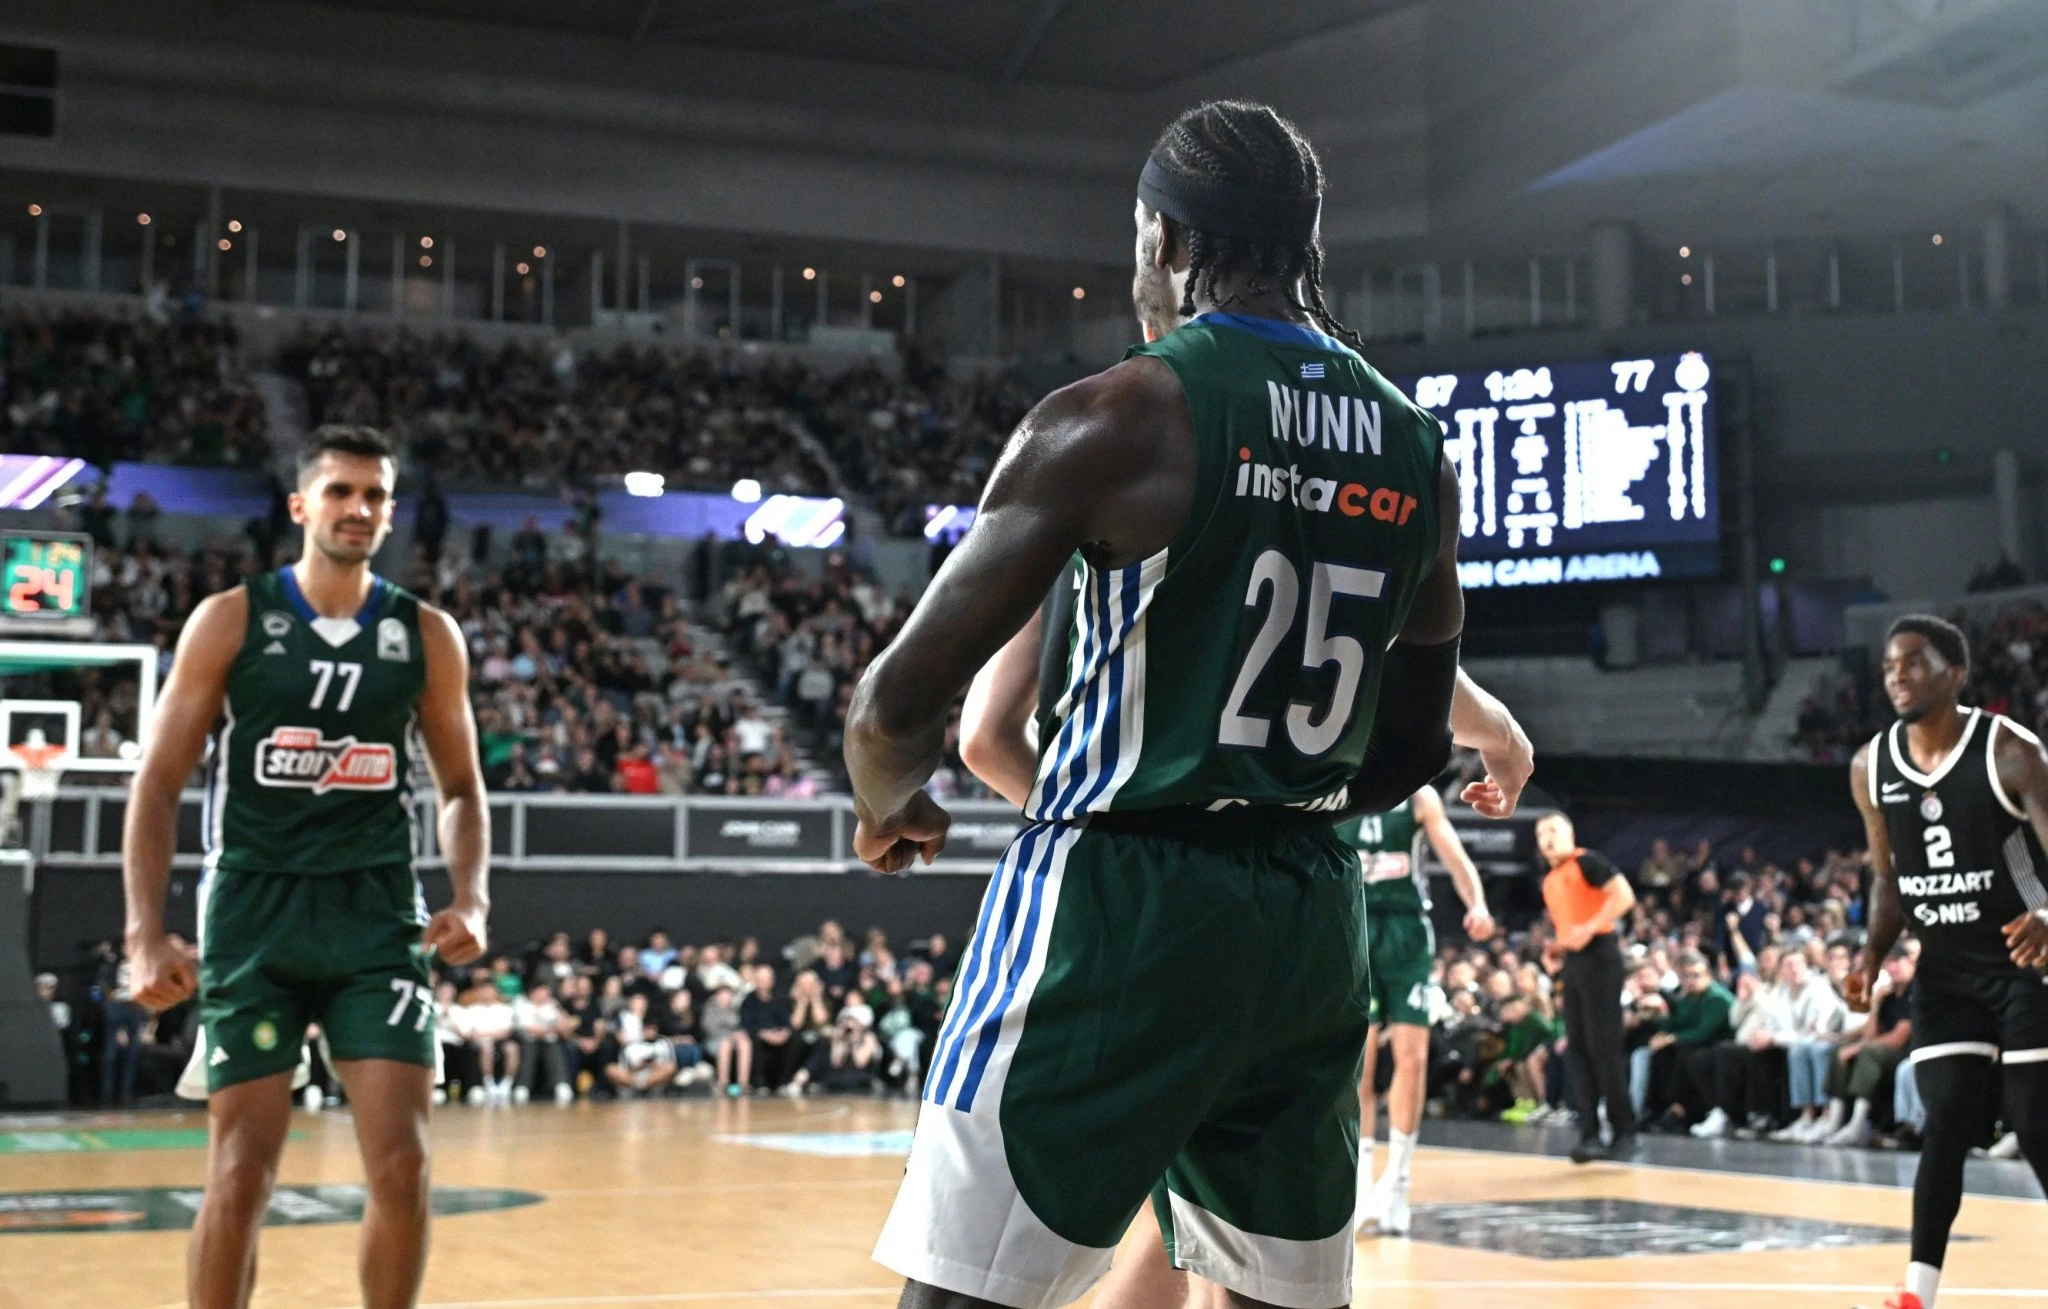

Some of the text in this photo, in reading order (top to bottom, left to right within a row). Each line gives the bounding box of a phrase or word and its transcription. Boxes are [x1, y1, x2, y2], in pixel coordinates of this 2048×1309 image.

[1611, 359, 1654, 393] 77
[1267, 380, 1382, 455] NUNN
[1235, 447, 1418, 526] instacar
[10, 564, 74, 613] 24
[1494, 556, 1562, 586] CAIN
[1564, 551, 1661, 582] ARENA
[1217, 549, 1386, 756] 25
[309, 659, 363, 712] 77
[1923, 825, 1955, 869] 2
[1898, 869, 1994, 897] MOZZART
[1938, 901, 1981, 925] NIS
